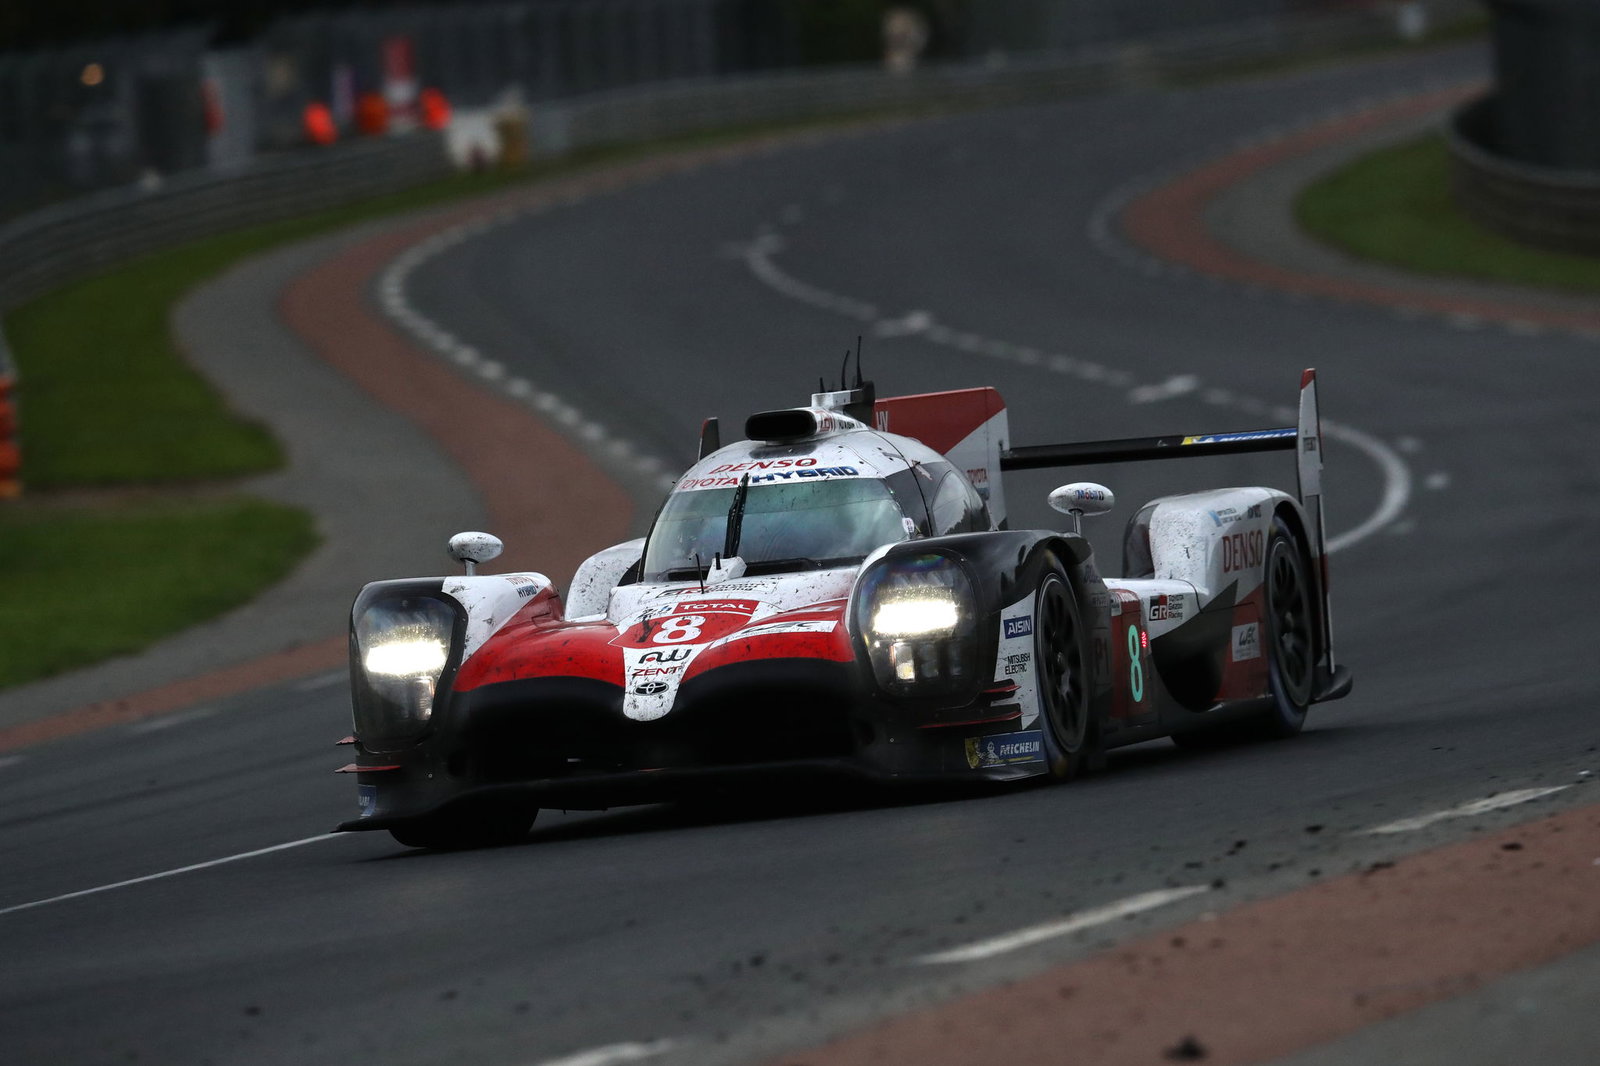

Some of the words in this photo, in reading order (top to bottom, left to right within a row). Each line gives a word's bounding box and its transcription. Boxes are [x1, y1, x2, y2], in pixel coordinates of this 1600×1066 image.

[709, 458, 817, 474] DENSO
[682, 477, 739, 490] TOYOTA
[752, 466, 859, 483] HYBRID
[1222, 530, 1263, 573] DENSO
[681, 602, 751, 612] TOTAL
[1150, 605, 1167, 620] GR
[652, 614, 706, 644] 8
[1007, 620, 1031, 636] AISIN
[1128, 624, 1144, 702] 8
[632, 666, 682, 677] ZENT
[1000, 741, 1040, 757] MICHELIN
